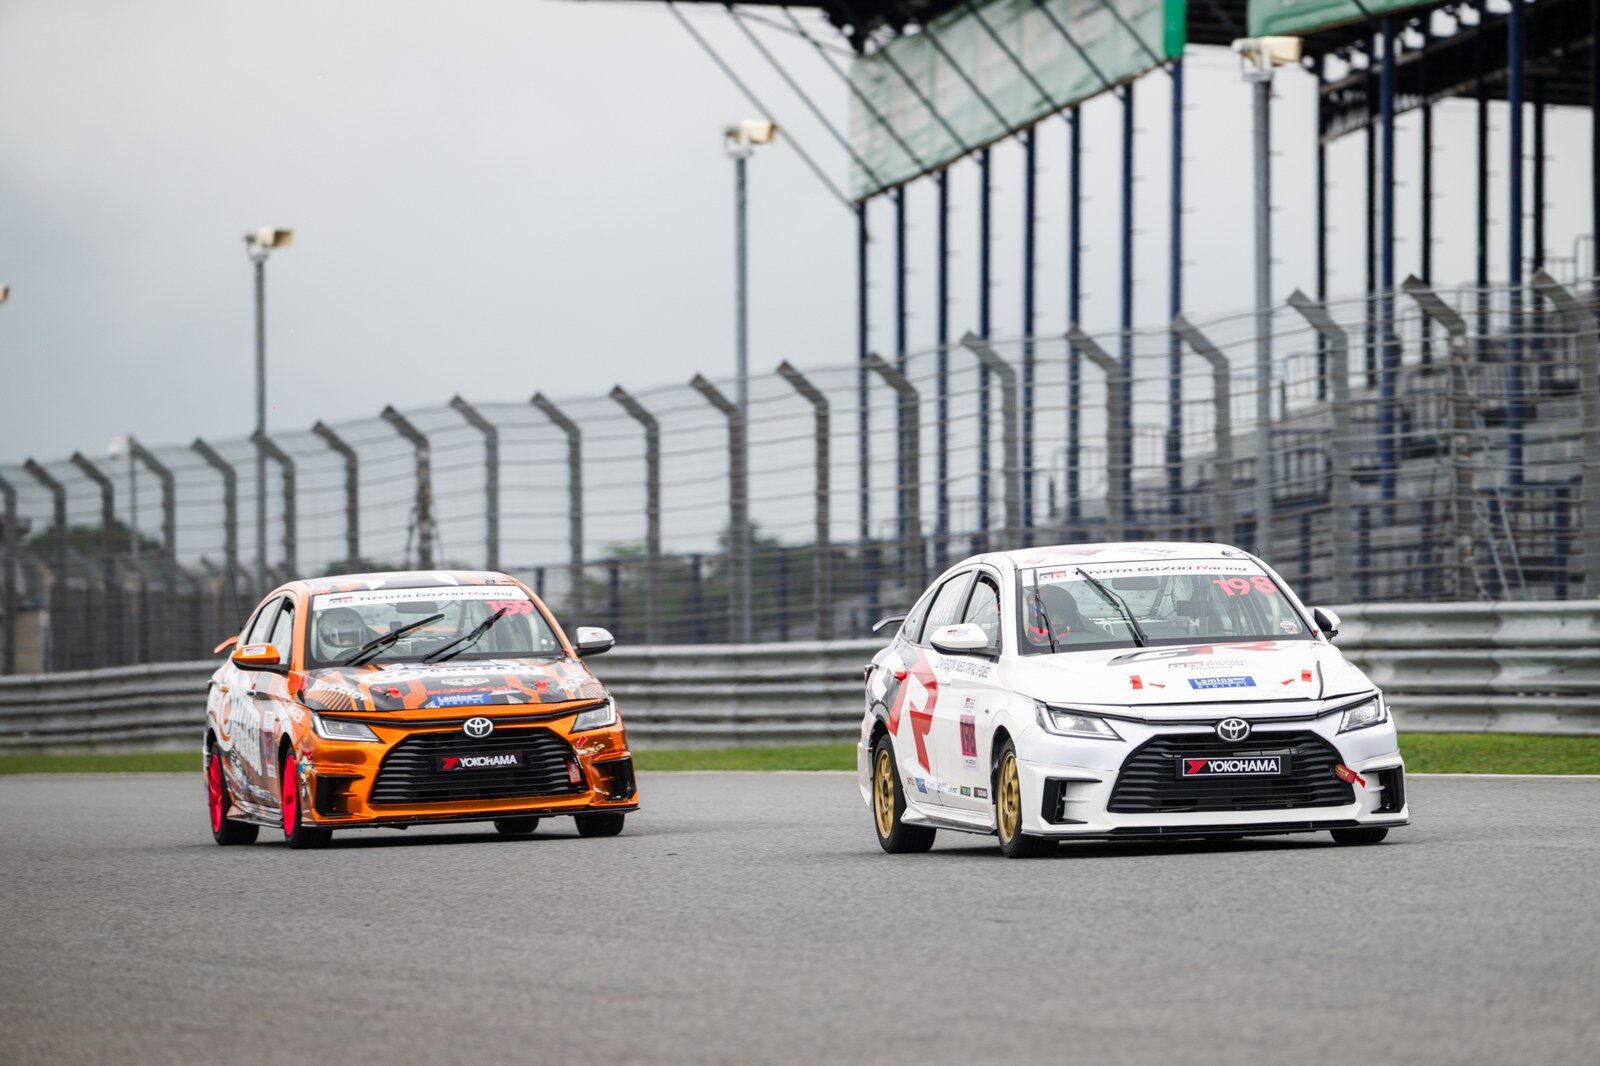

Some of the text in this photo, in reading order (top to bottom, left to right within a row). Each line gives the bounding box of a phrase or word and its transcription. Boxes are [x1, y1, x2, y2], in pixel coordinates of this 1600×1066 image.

[1072, 567, 1132, 576] TOYOTA
[1196, 564, 1247, 573] Racing
[1212, 576, 1276, 597] 198
[459, 755, 518, 768] YOKOHAMA
[1207, 759, 1278, 772] YOKOHAMA
